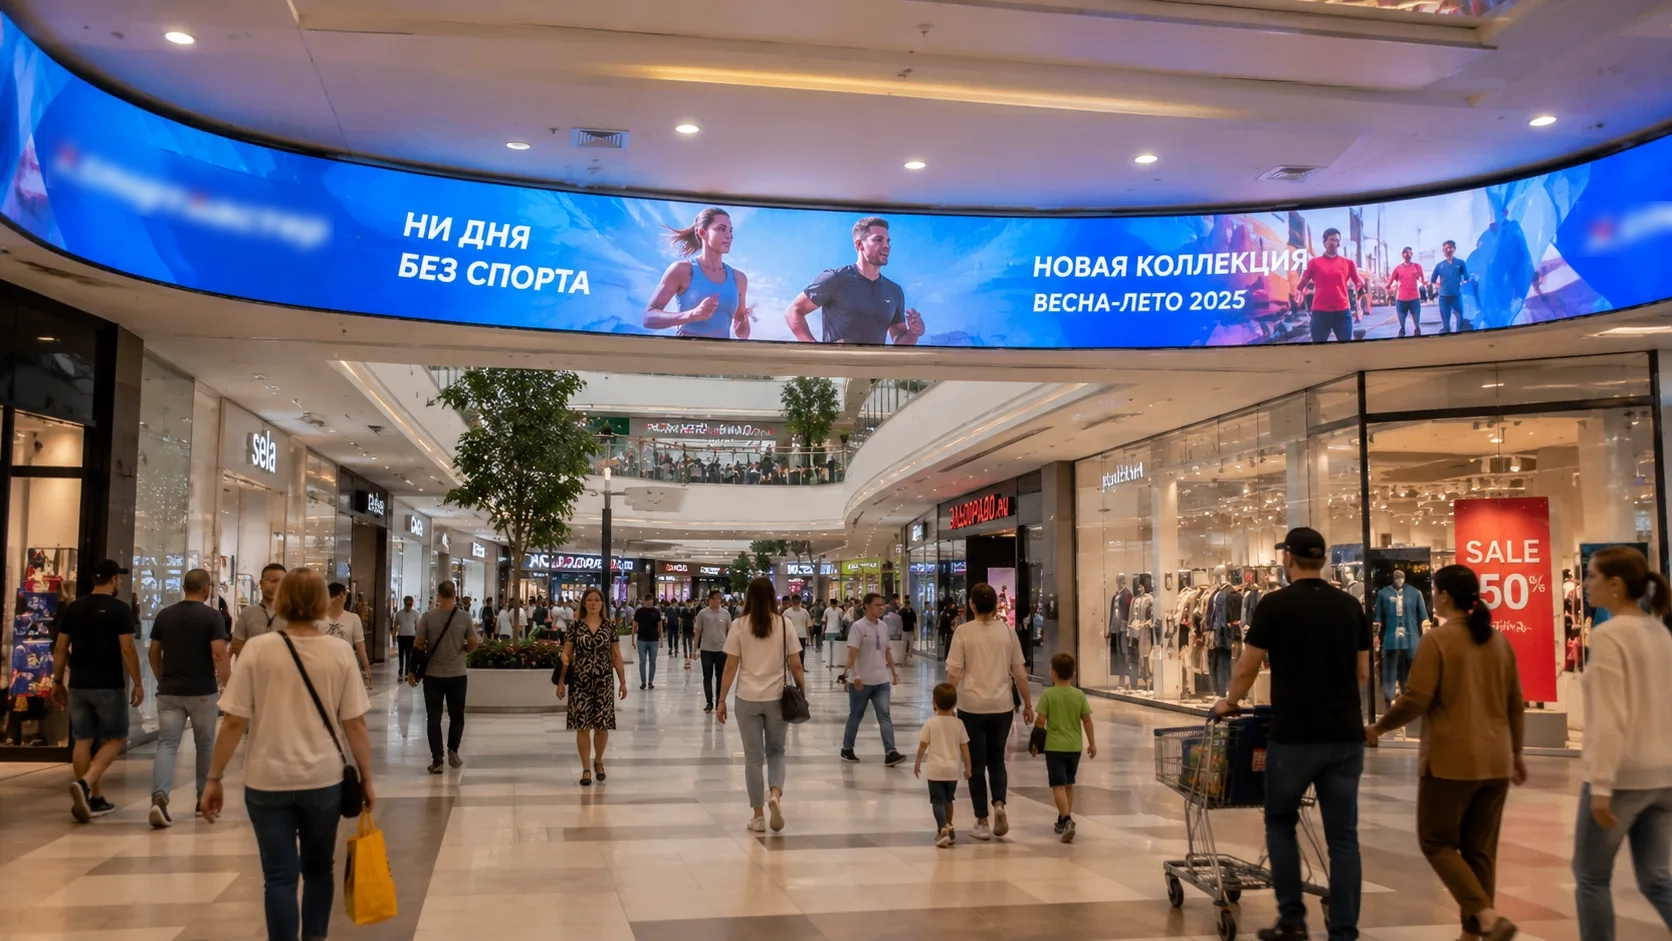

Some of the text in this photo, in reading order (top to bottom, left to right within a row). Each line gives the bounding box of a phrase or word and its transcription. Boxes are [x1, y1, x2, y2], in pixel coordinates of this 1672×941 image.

[403, 212, 531, 250] НИ ДНЯ
[398, 252, 590, 295] БЕЗ СПОРТА
[1033, 248, 1308, 278] НОВАЯ КОЛЛЕКЦИЯ
[1033, 290, 1247, 312] ВЕСНА-ЛЕТО 2025
[252, 430, 277, 474] sela
[1466, 539, 1541, 564] SALE
